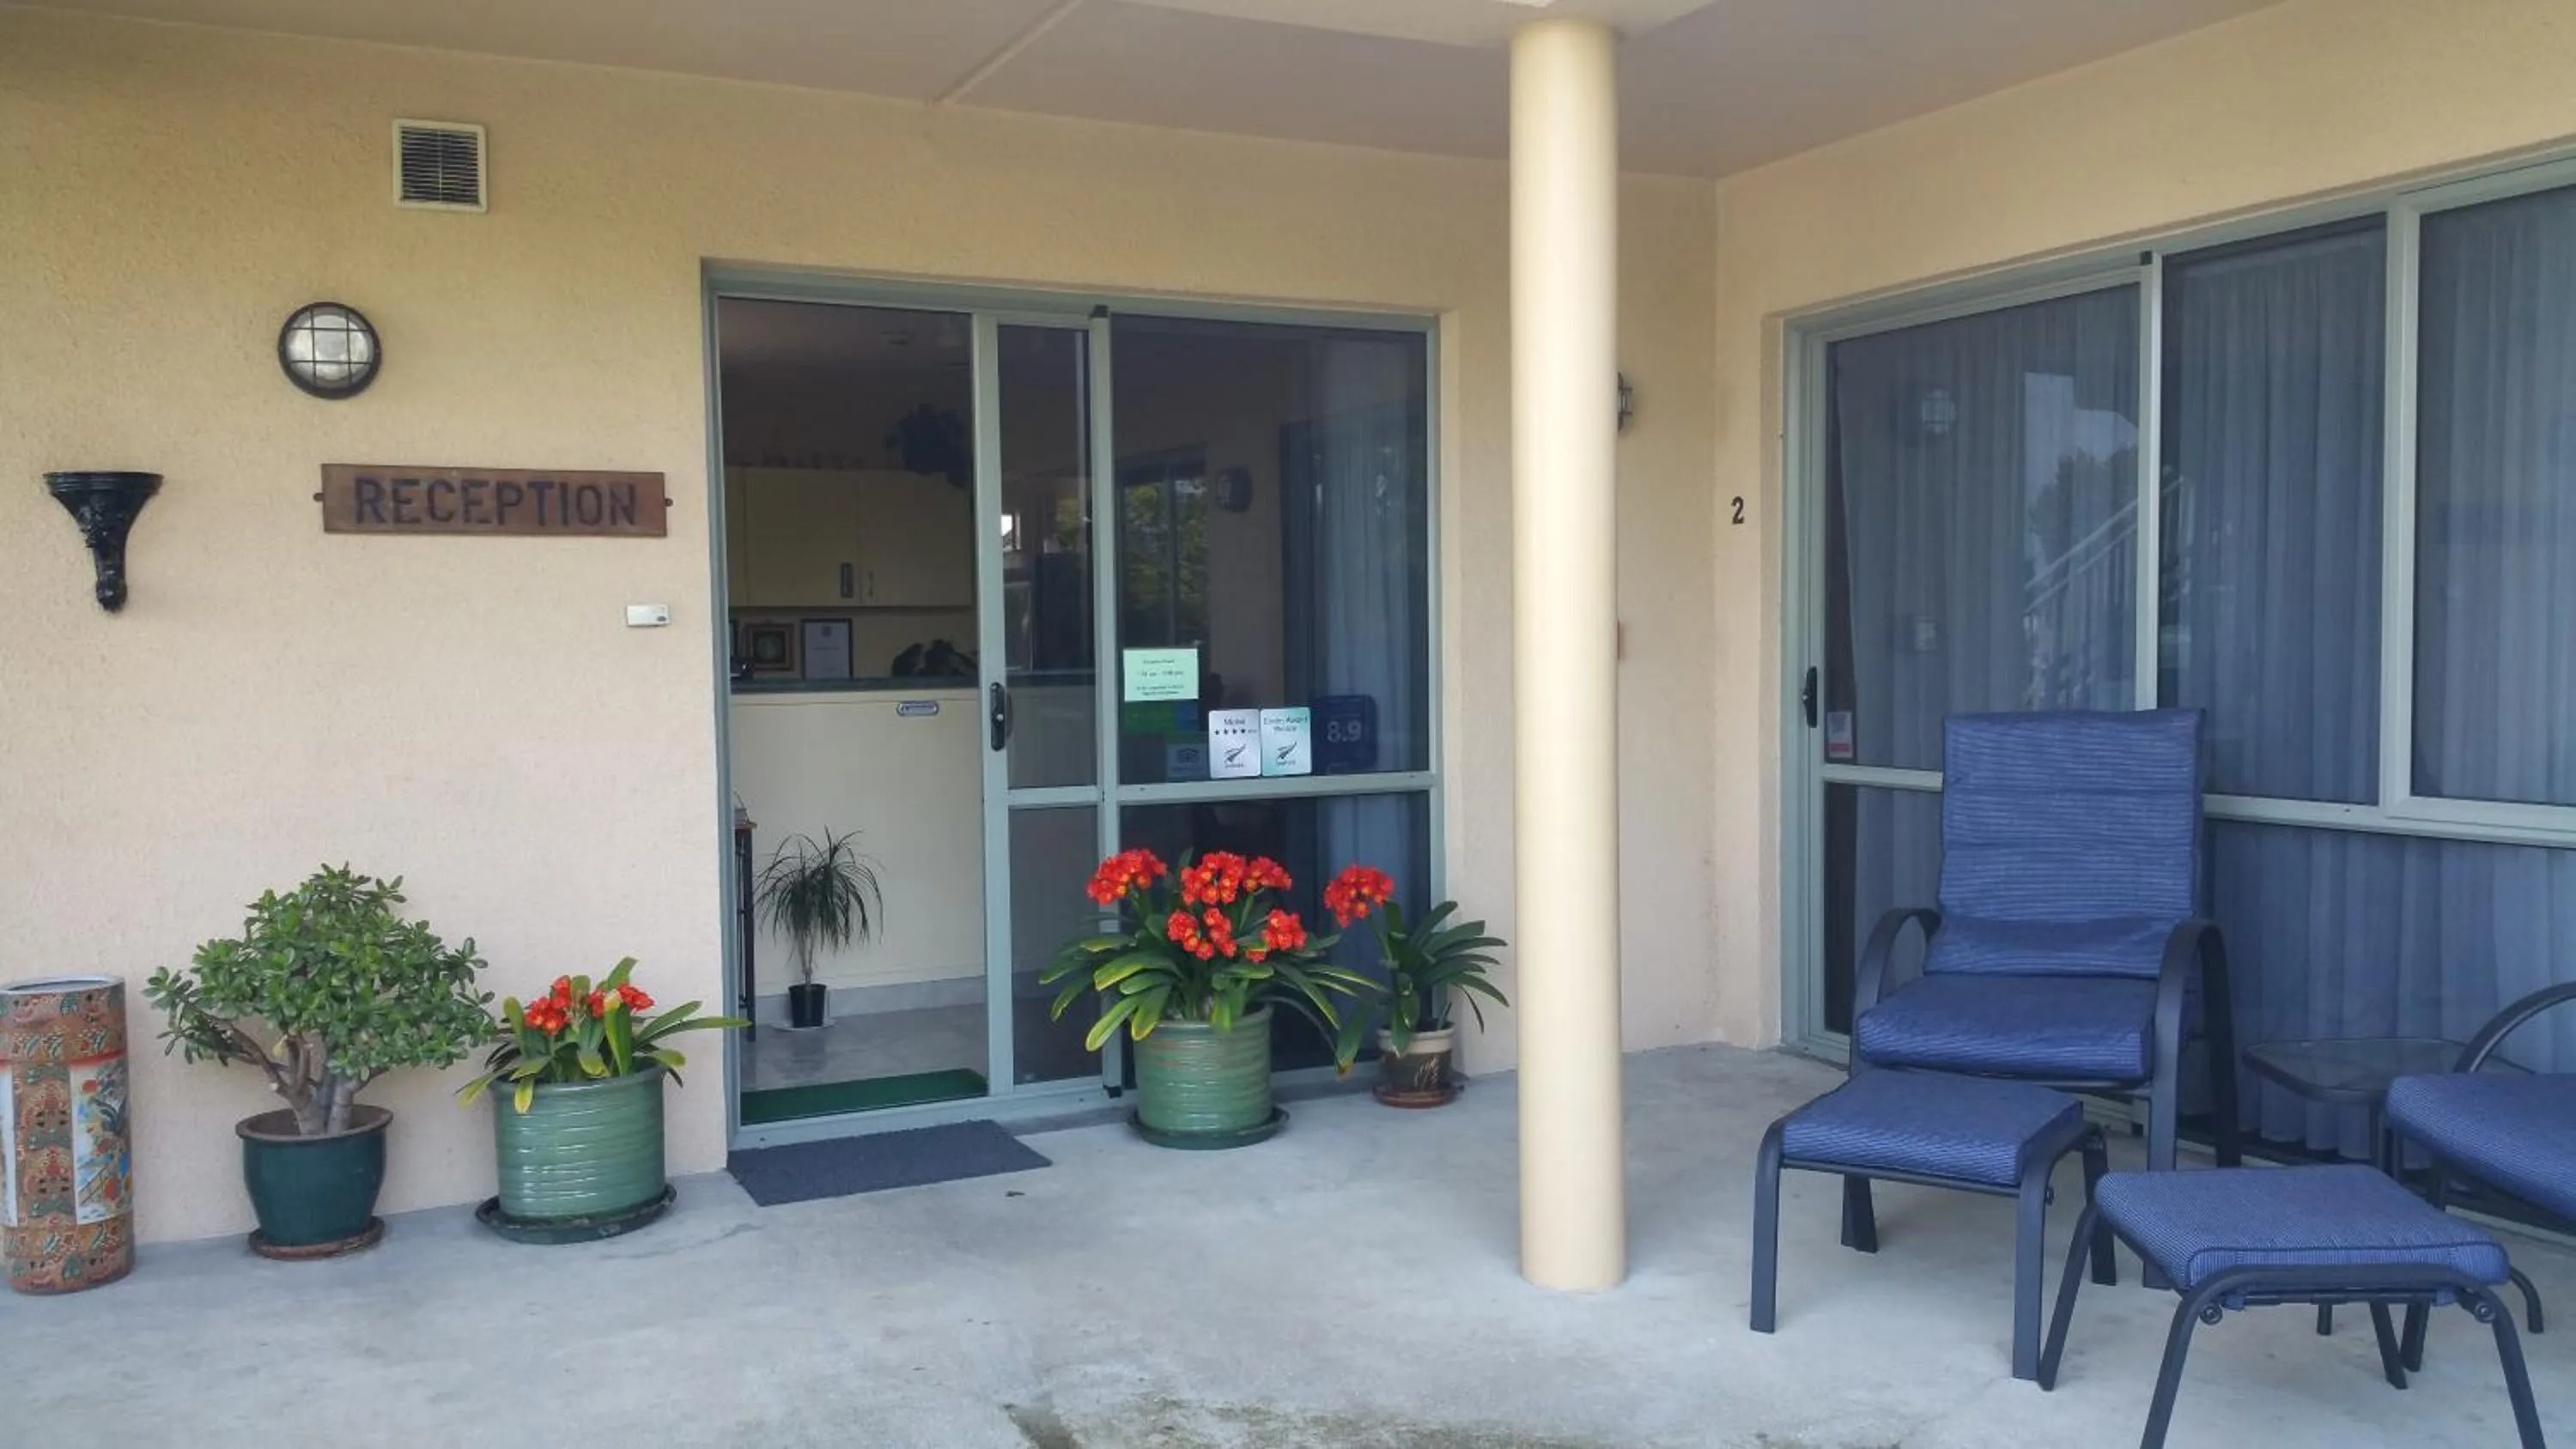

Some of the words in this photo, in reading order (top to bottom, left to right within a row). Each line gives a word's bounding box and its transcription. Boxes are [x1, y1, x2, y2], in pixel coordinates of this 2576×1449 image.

[354, 476, 637, 526] RECEPTION
[1731, 495, 1745, 525] 2
[1326, 720, 1362, 744] 8.9
